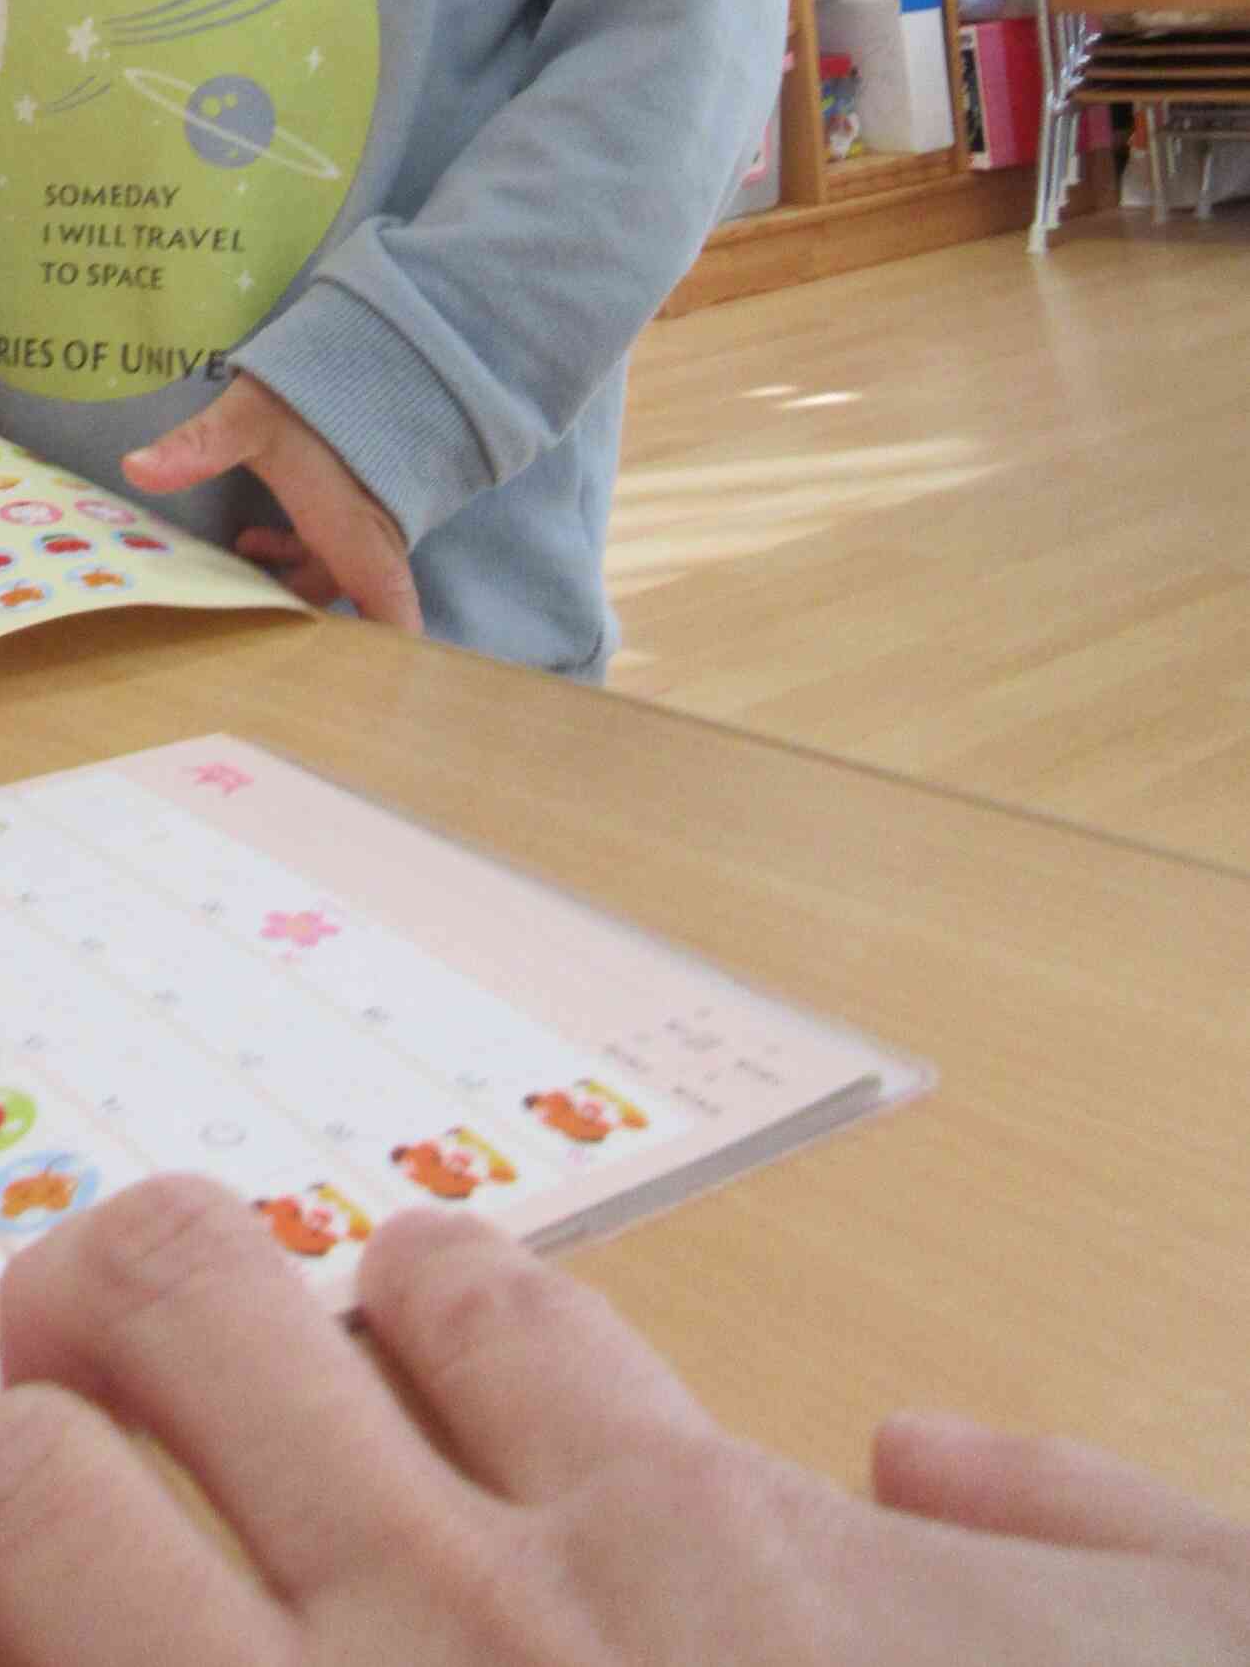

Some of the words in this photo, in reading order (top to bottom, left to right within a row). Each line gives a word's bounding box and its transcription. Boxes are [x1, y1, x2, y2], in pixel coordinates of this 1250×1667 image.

[44, 182, 181, 210] SOMEDAY
[42, 222, 51, 245] I
[58, 223, 127, 248] WILL
[132, 223, 247, 254] TRAVEL
[40, 260, 80, 286] TO
[85, 262, 168, 291] SPACE
[63, 337, 109, 373] OF
[121, 342, 228, 382] UNIVE
